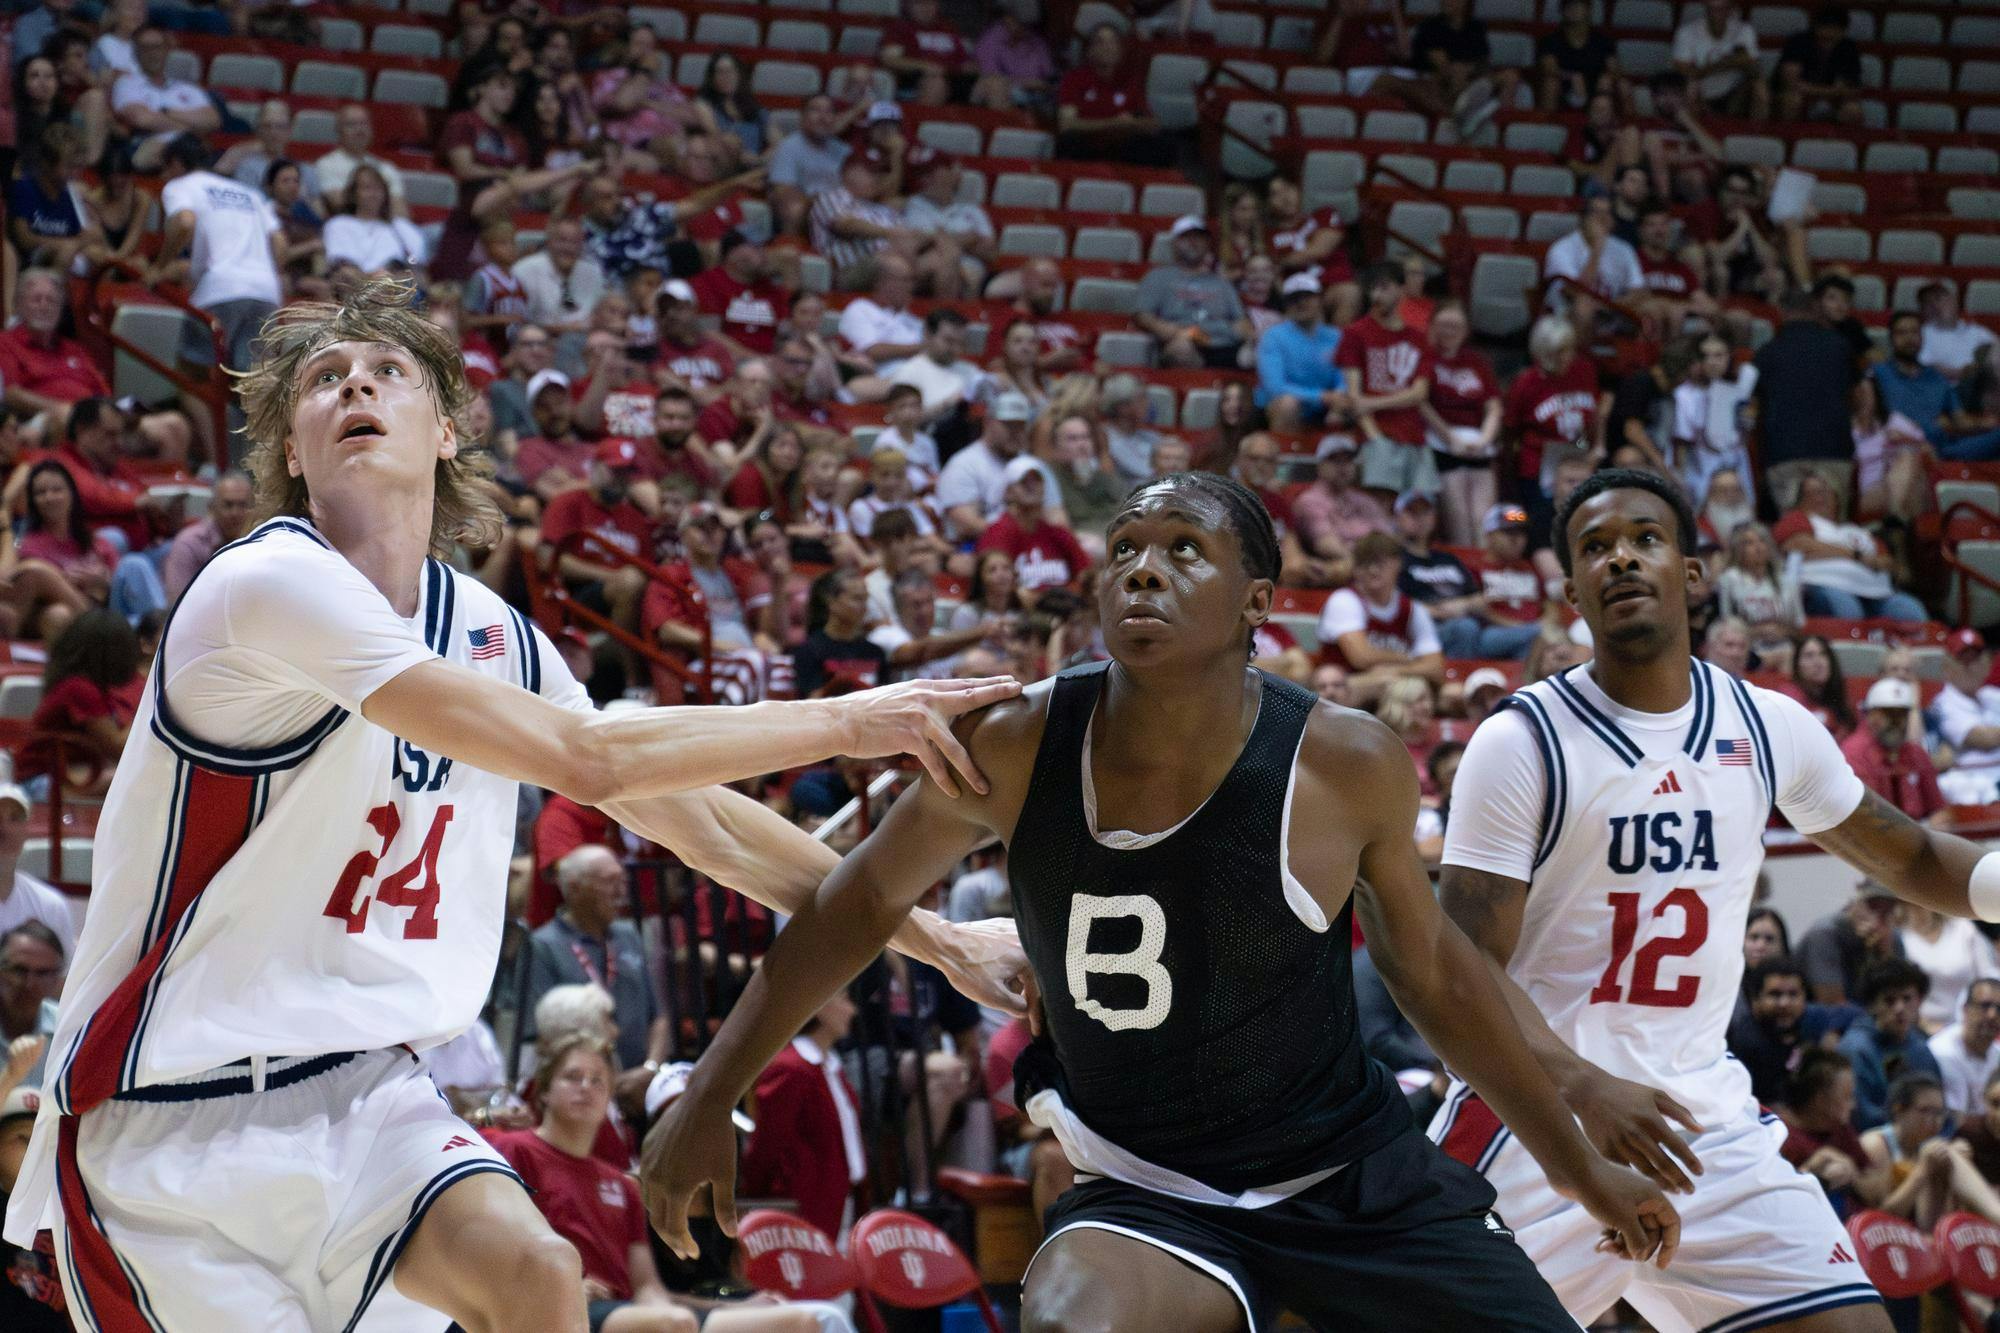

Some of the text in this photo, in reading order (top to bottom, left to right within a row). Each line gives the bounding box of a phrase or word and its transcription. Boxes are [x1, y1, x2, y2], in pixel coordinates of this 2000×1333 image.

[322, 800, 454, 940] 24
[1607, 810, 1719, 874] USA
[1065, 892, 1173, 1032] B
[1589, 888, 1709, 1008] 12
[743, 1225, 832, 1259] INDIANA
[867, 1225, 953, 1258] INDIANA
